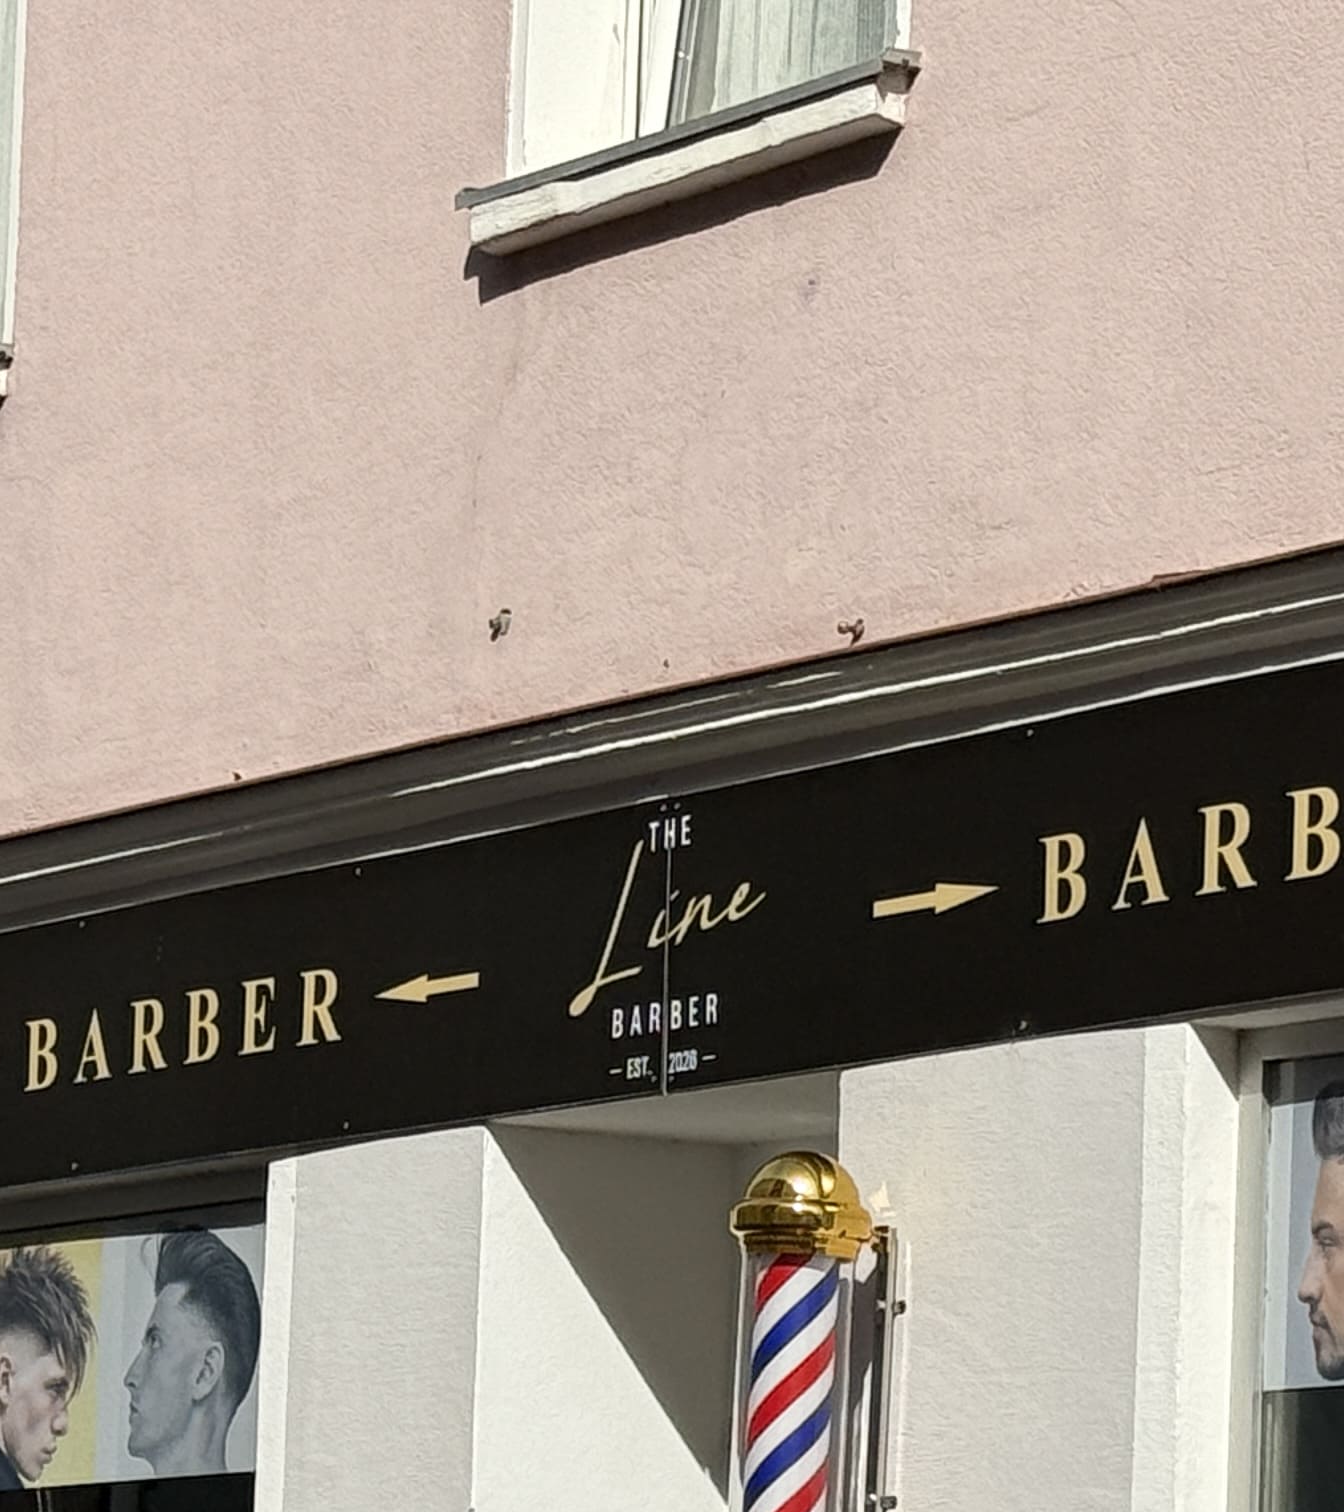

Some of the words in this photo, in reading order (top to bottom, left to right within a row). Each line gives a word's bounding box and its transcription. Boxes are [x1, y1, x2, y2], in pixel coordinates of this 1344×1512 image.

[648, 814, 692, 852] THE
[569, 839, 766, 1016] Line
[24, 968, 342, 1092] BARBER
[611, 993, 718, 1039] BARBER
